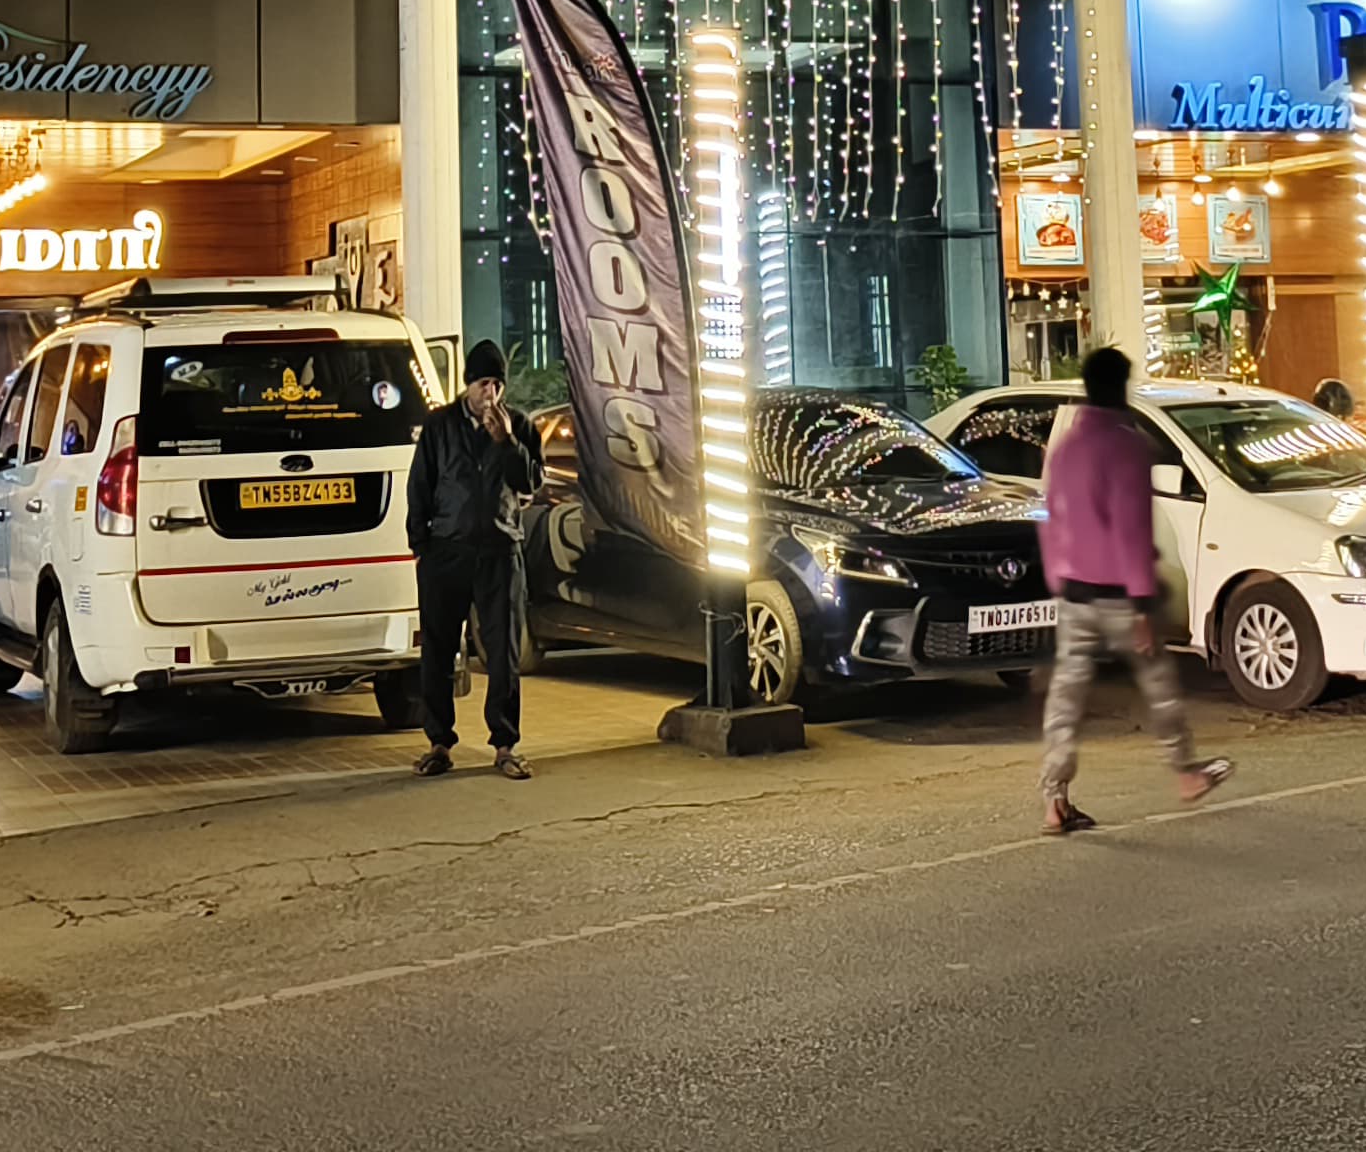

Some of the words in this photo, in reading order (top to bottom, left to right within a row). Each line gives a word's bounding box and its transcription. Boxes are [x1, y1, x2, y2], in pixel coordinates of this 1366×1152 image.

[562, 87, 666, 473] ROOMS
[251, 481, 352, 504] TN55BZ4133
[286, 680, 327, 696] XYLO
